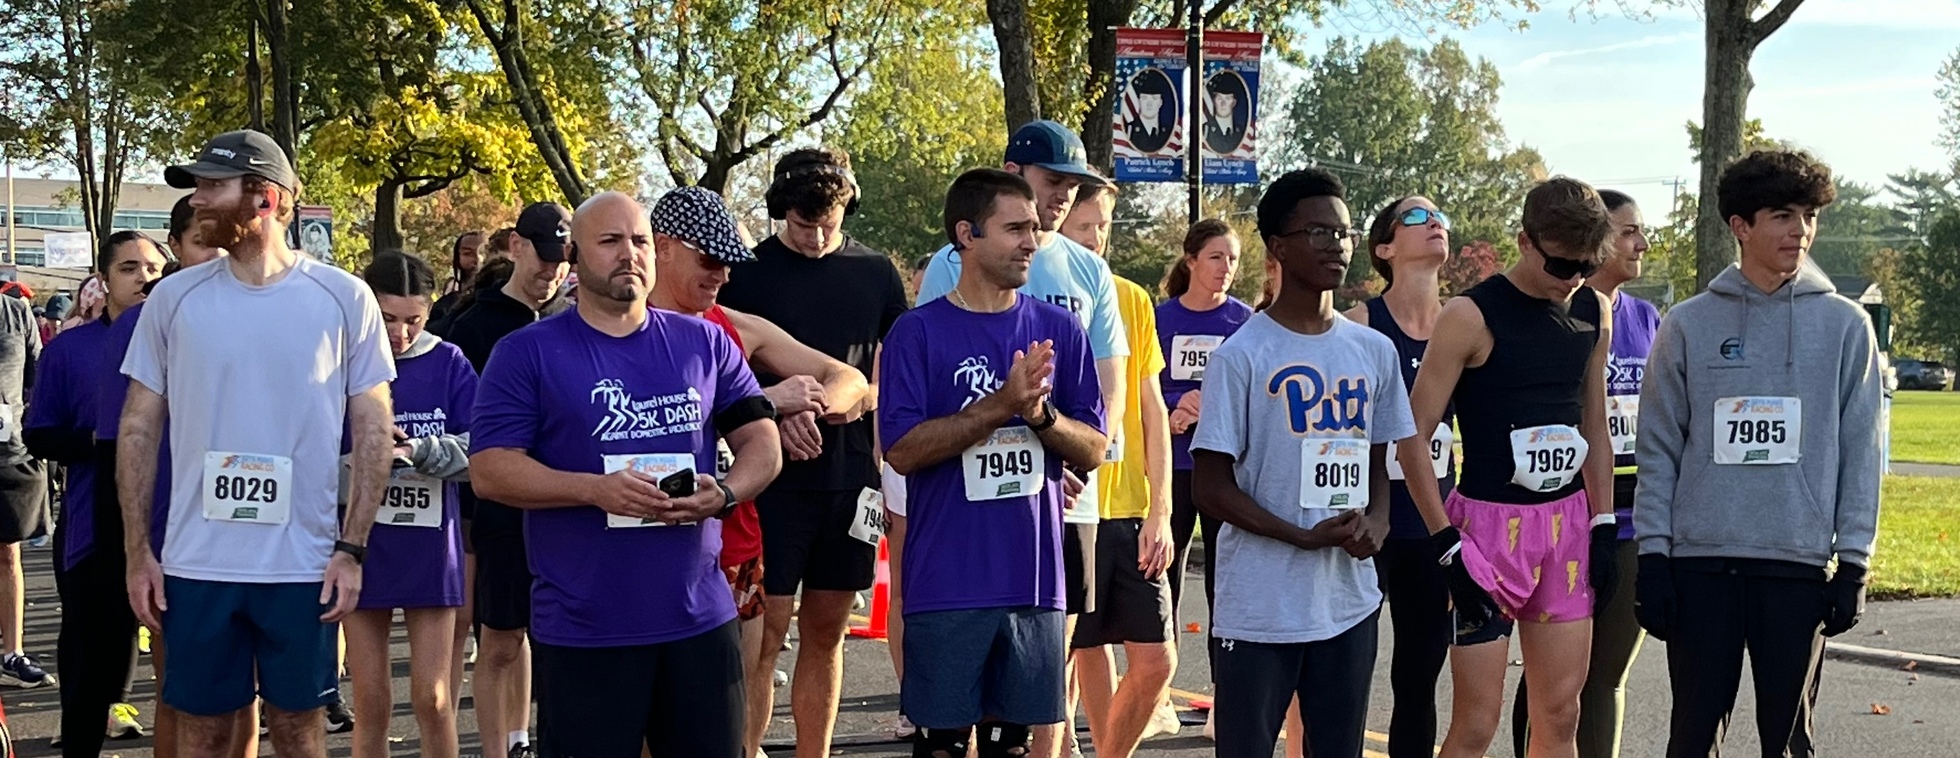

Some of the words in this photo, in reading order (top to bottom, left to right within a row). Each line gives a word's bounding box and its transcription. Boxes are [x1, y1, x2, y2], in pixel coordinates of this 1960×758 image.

[1180, 350, 1213, 367] 795
[658, 393, 687, 406] House
[1267, 363, 1370, 436] Pitt
[638, 410, 660, 429] 5K
[664, 403, 702, 424] DASH
[412, 421, 445, 437] DASH
[1727, 420, 1786, 444] 7985
[976, 450, 1033, 479] 7949
[1526, 446, 1577, 474] 7962
[1315, 463, 1360, 487] 8019
[215, 475, 277, 503] 8029
